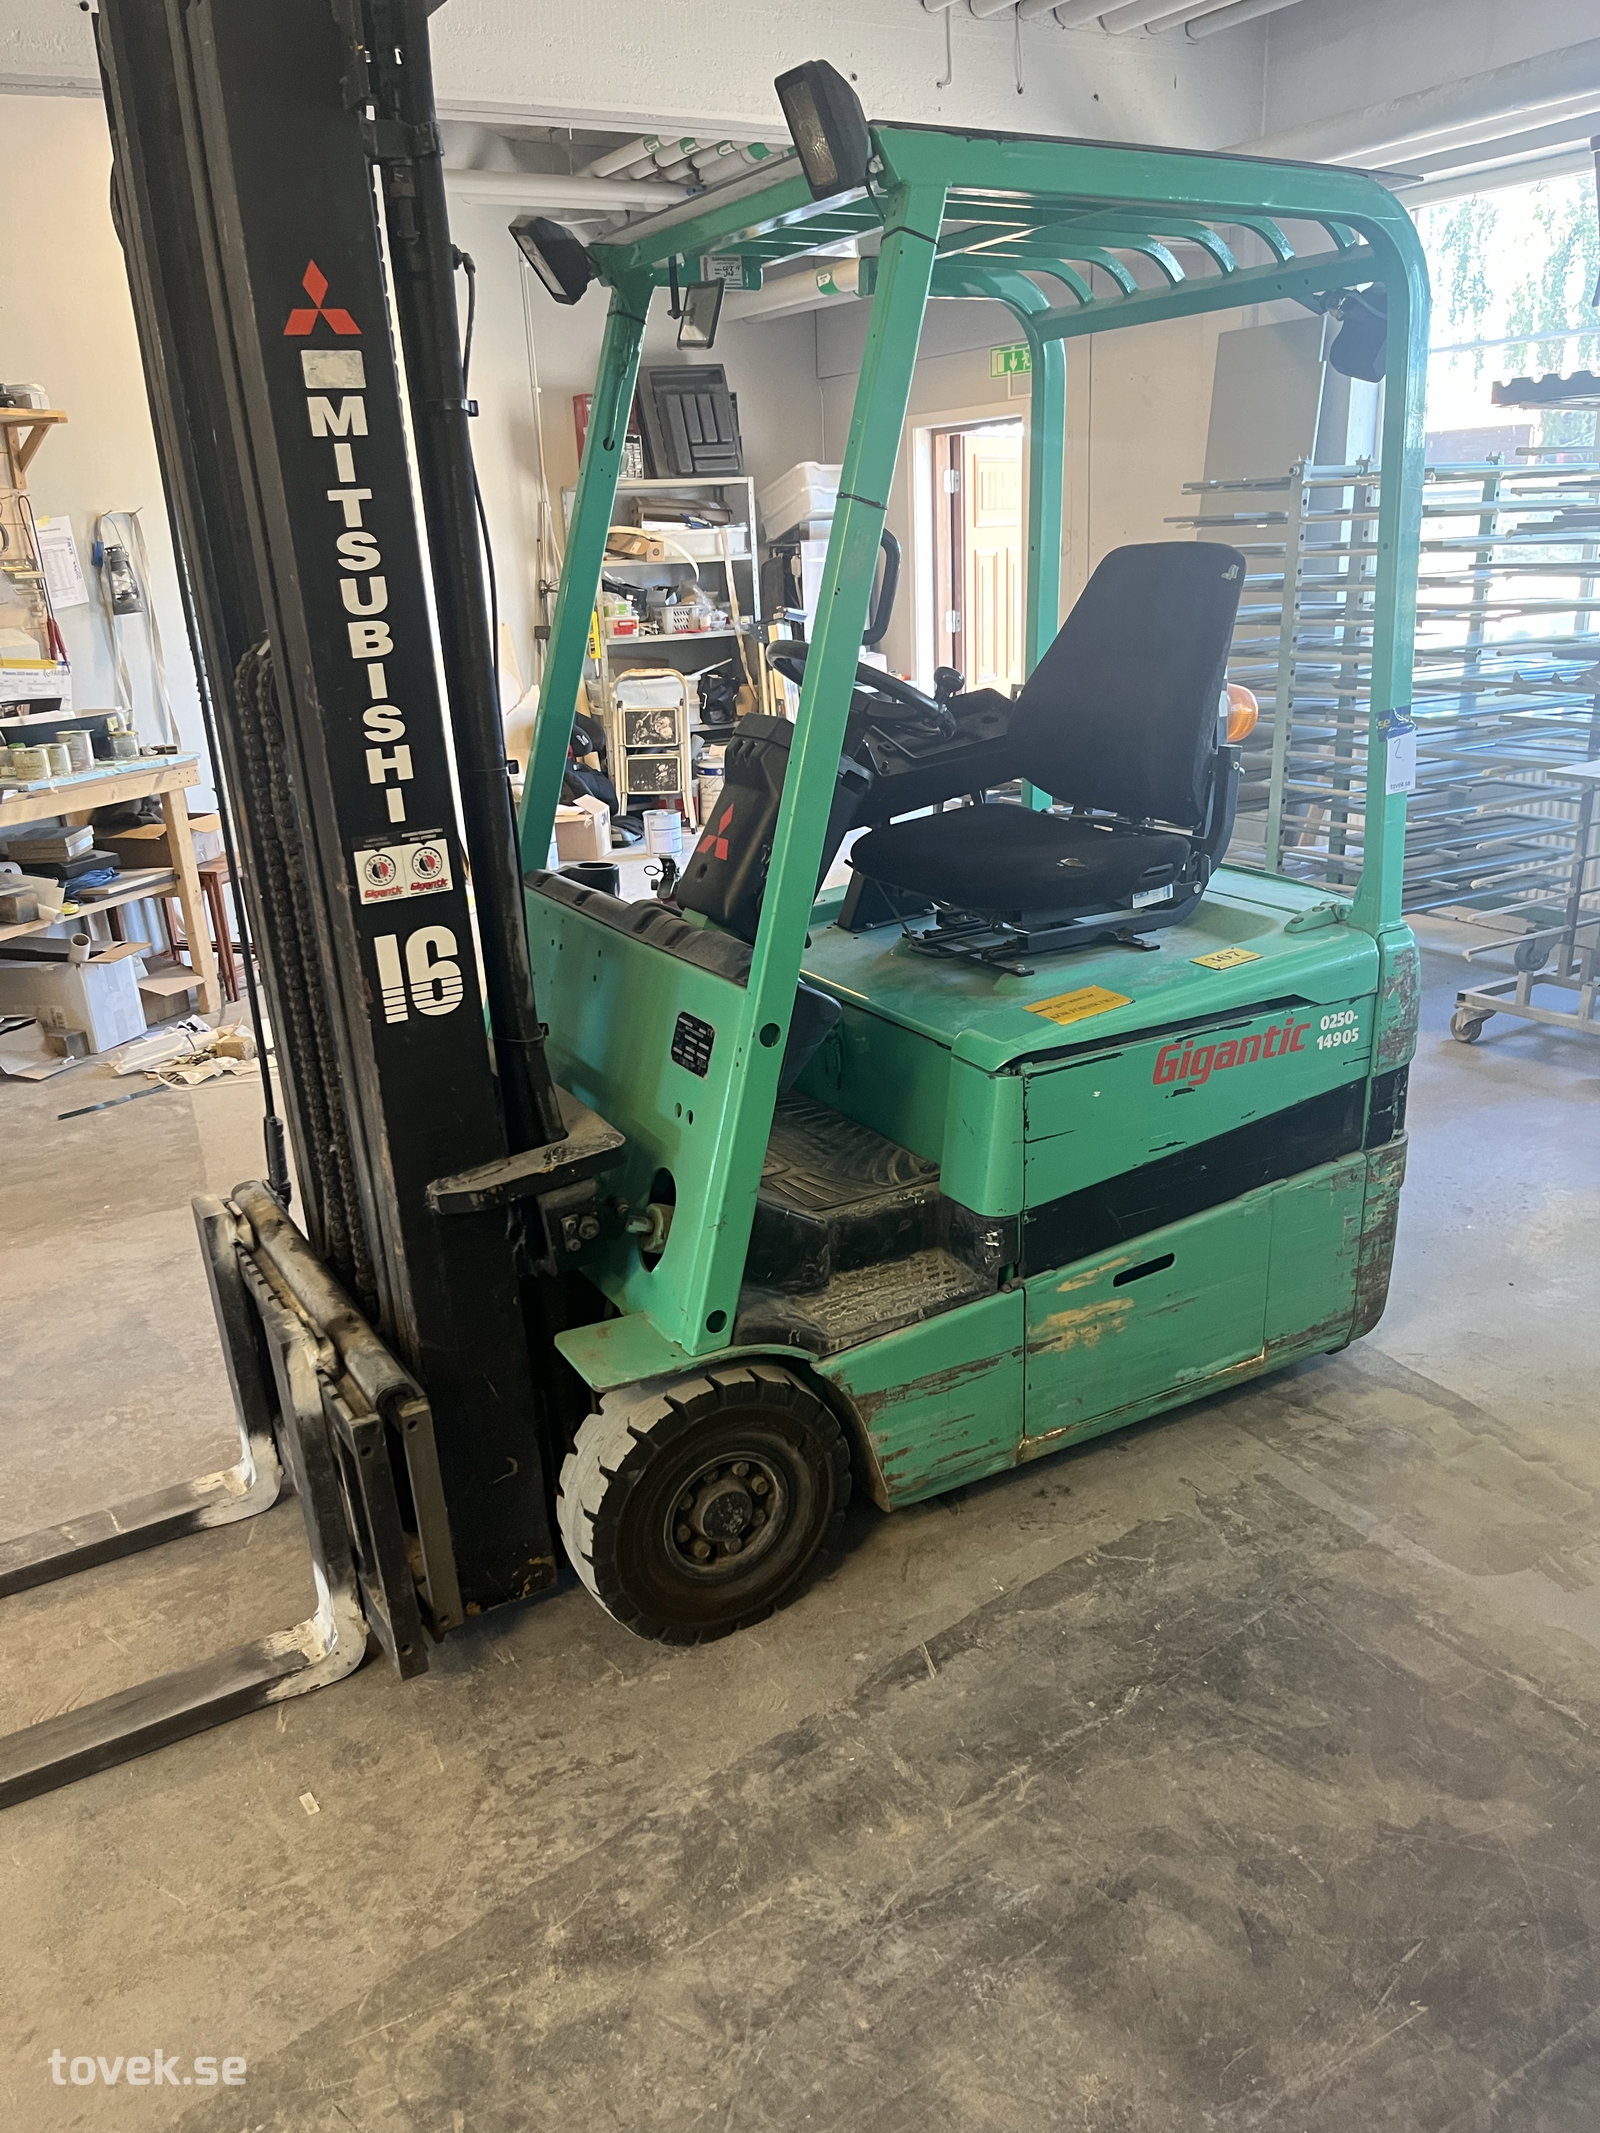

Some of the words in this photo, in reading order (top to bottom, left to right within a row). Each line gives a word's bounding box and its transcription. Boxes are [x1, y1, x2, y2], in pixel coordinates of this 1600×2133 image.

[307, 396, 414, 823] MITSUBISHI
[373, 925, 464, 1023] 16
[1153, 1017, 1311, 1087] Gigantic
[1316, 1027, 1360, 1050] 14905
[1320, 1010, 1359, 1030] 0250-
